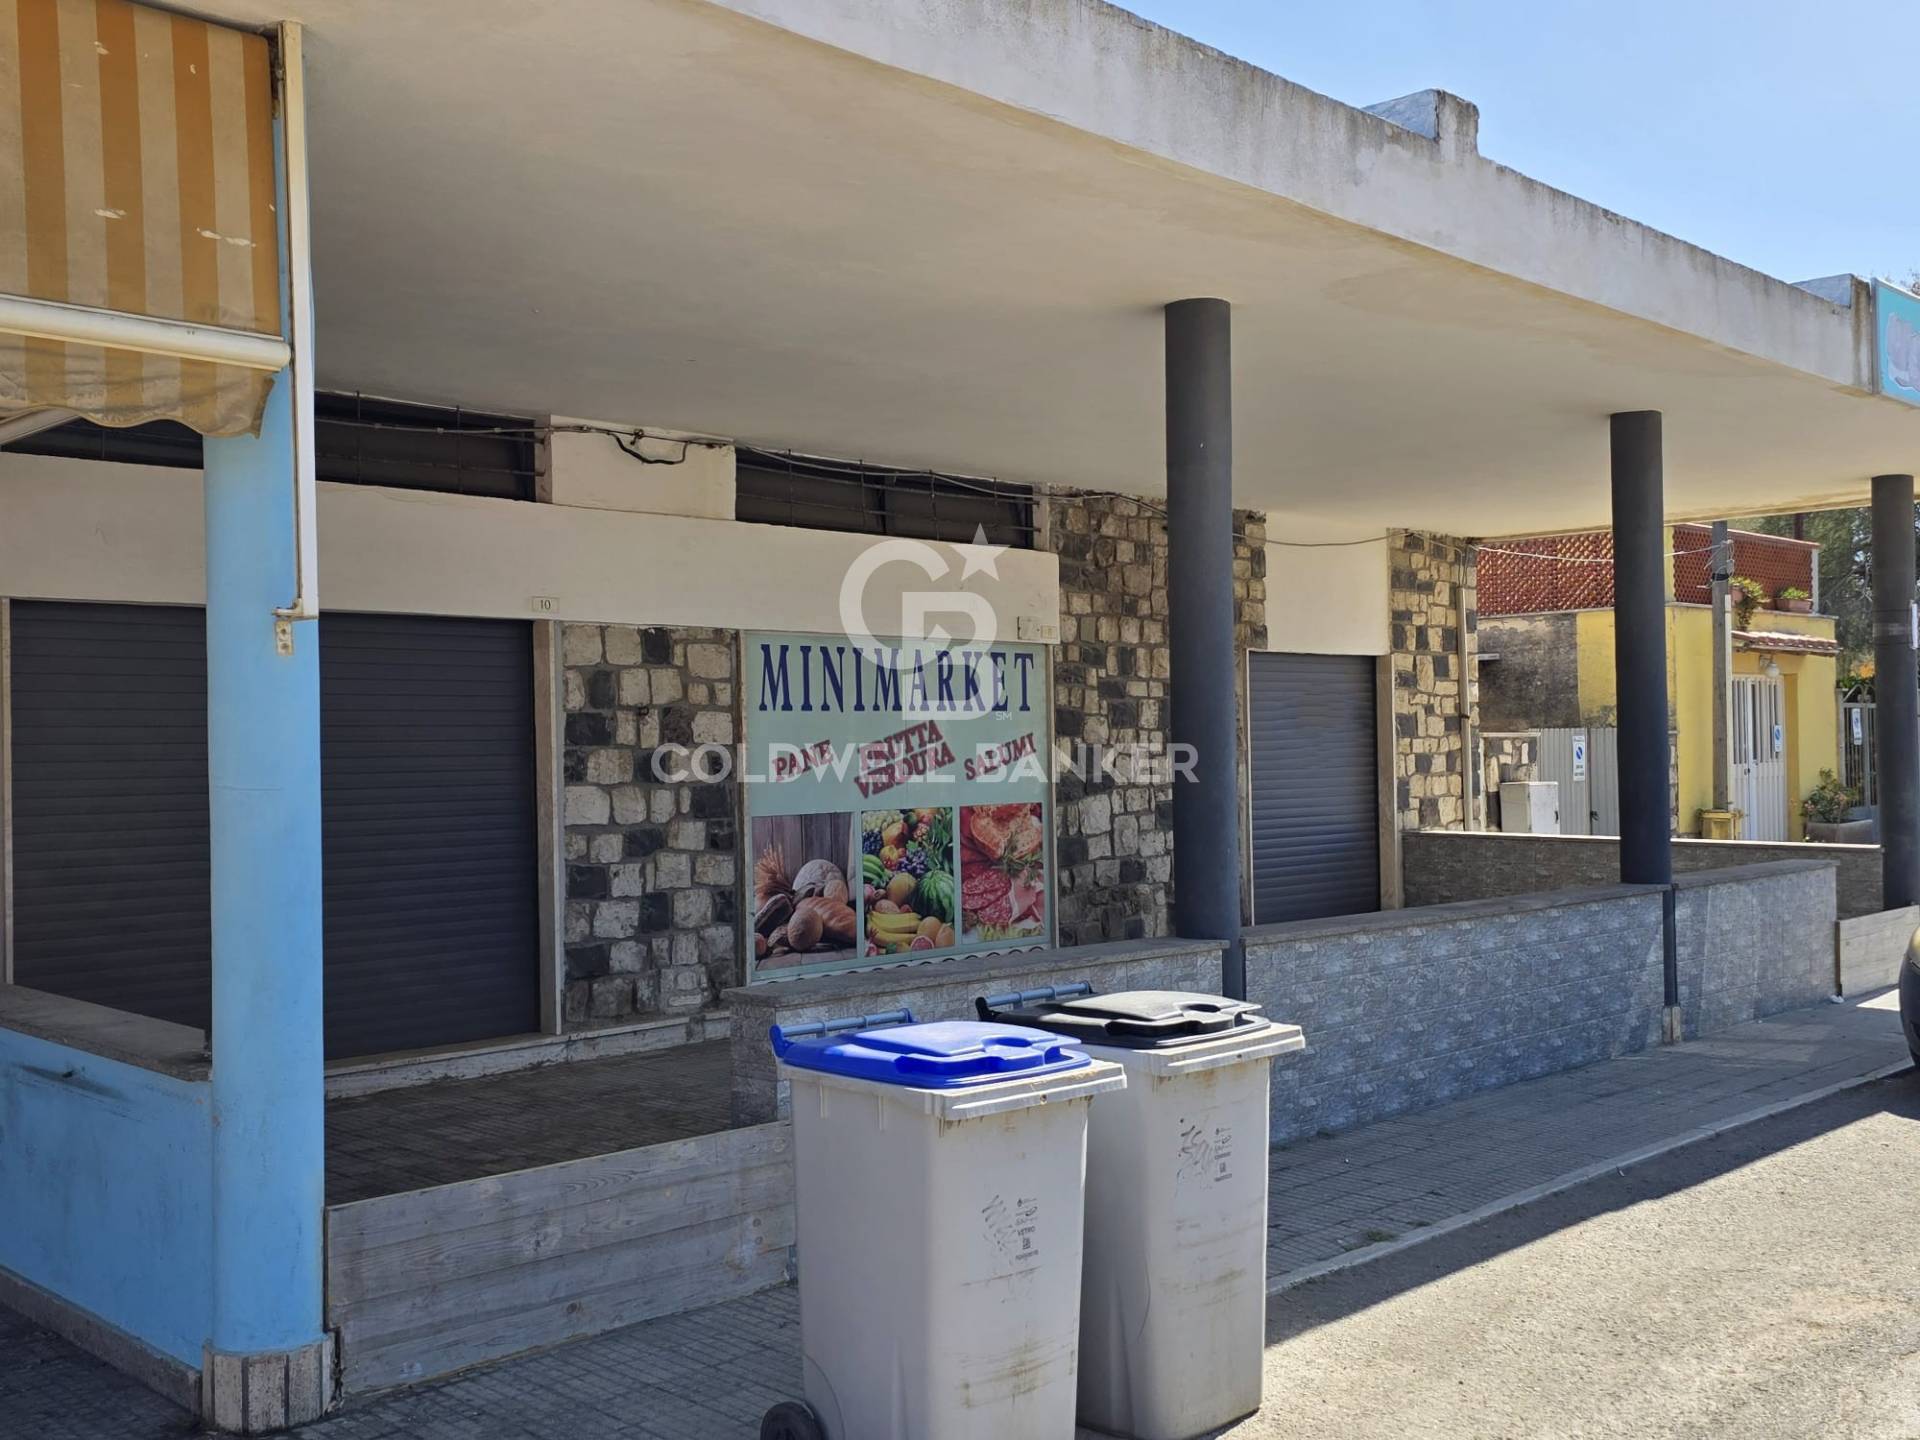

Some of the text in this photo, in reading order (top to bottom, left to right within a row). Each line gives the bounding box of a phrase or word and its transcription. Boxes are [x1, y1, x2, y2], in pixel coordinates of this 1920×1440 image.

[540, 599, 551, 610] 10
[759, 643, 1034, 713] MINIMARKET
[772, 740, 834, 782] PANE
[854, 740, 956, 799] VERDURA
[857, 719, 944, 773] FRUTTA
[964, 732, 1037, 781] SALUMI
